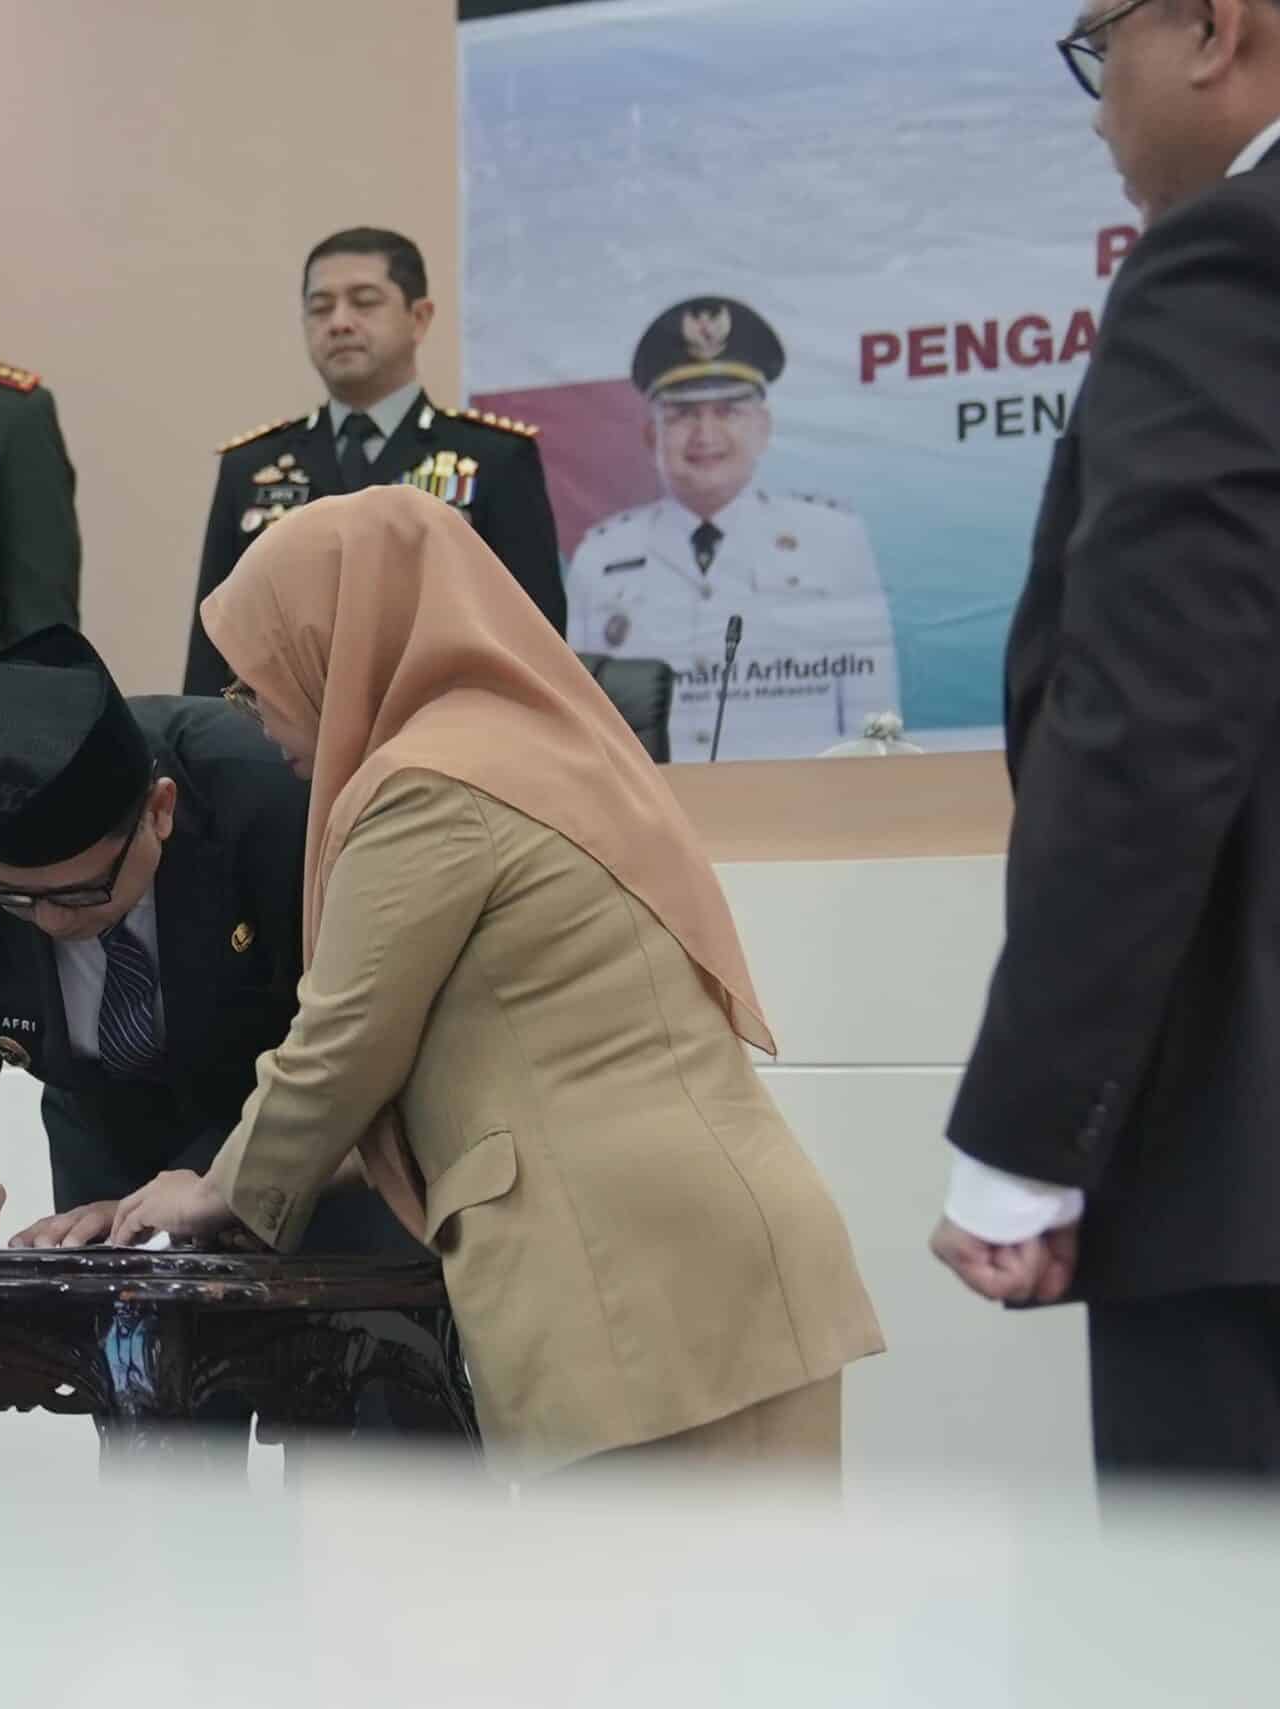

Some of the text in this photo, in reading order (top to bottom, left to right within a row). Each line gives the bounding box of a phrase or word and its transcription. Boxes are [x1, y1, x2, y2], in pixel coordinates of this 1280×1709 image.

[860, 309, 1098, 384] PENGA
[957, 393, 1066, 442] PEN
[746, 654, 875, 682] Arifuddin
